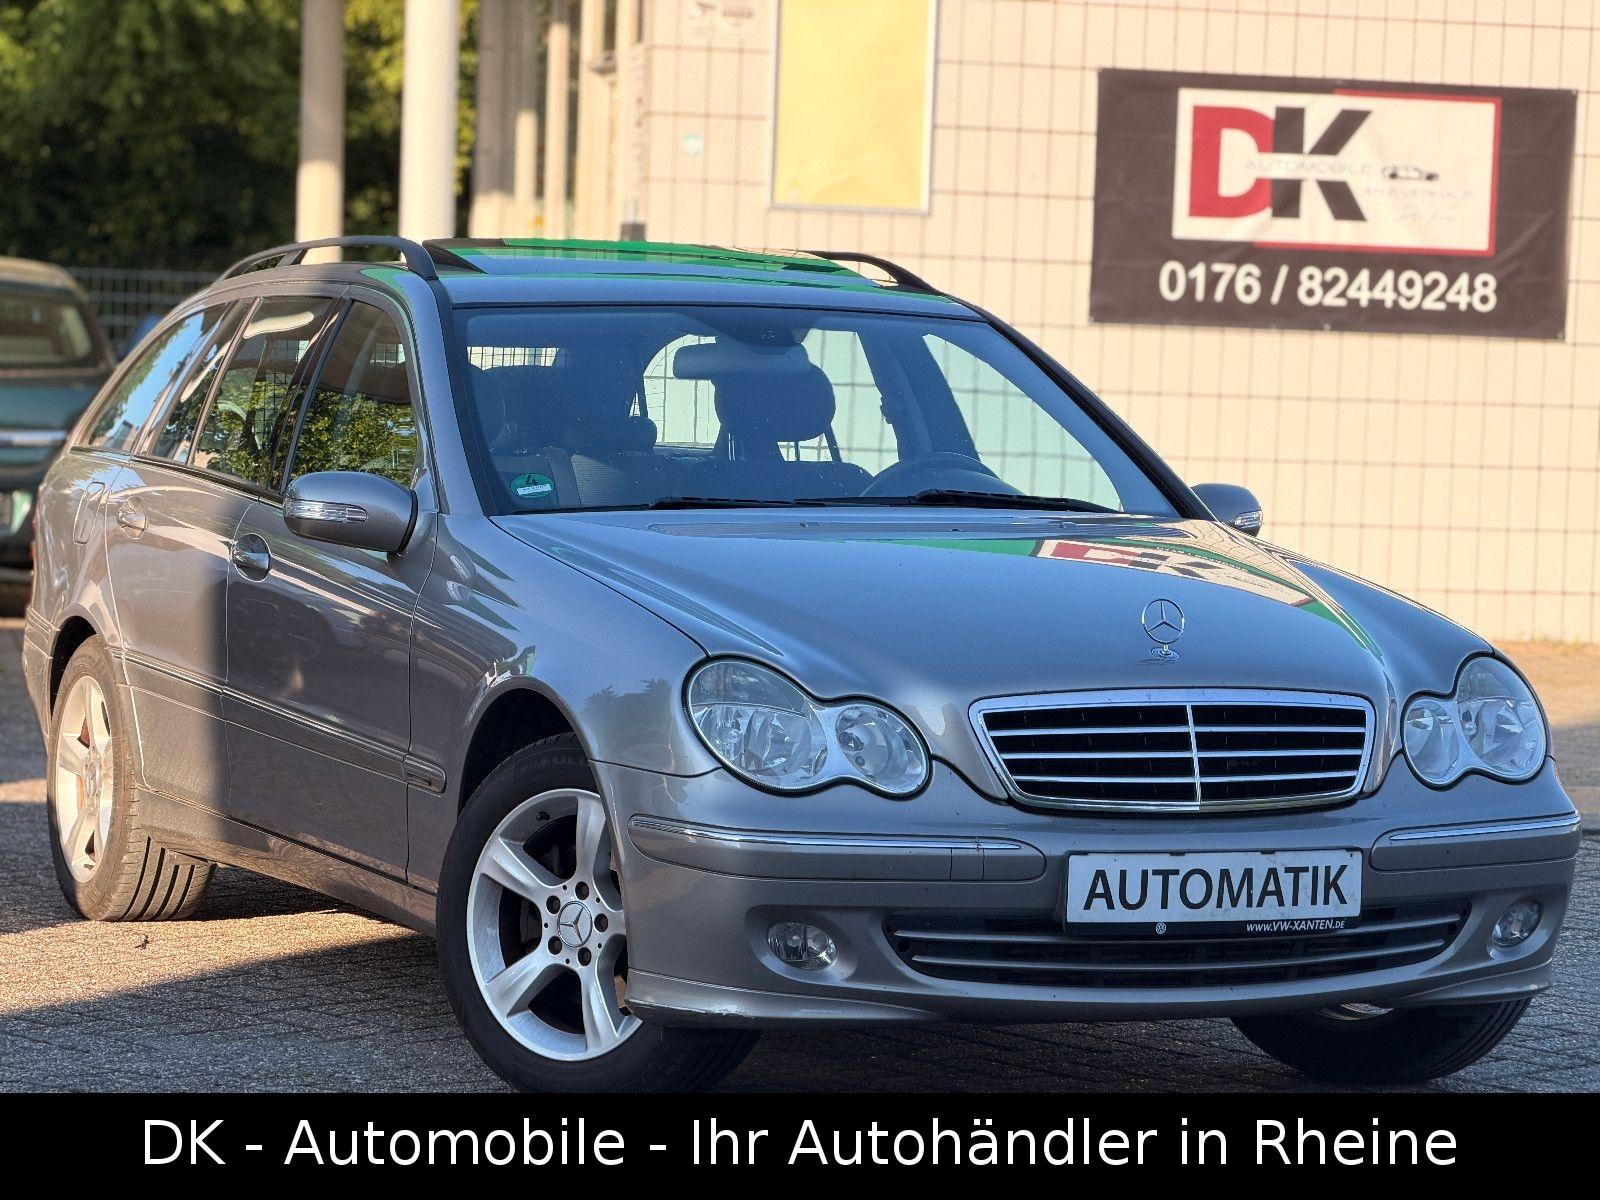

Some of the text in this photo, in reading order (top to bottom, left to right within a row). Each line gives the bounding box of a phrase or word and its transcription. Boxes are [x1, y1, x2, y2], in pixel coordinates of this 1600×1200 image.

[1188, 105, 1373, 222] DK
[1244, 156, 1374, 177] AUTOMOBILE
[1158, 260, 1498, 313] 0176 / 82449248
[1082, 864, 1349, 911] AUTOMATIK
